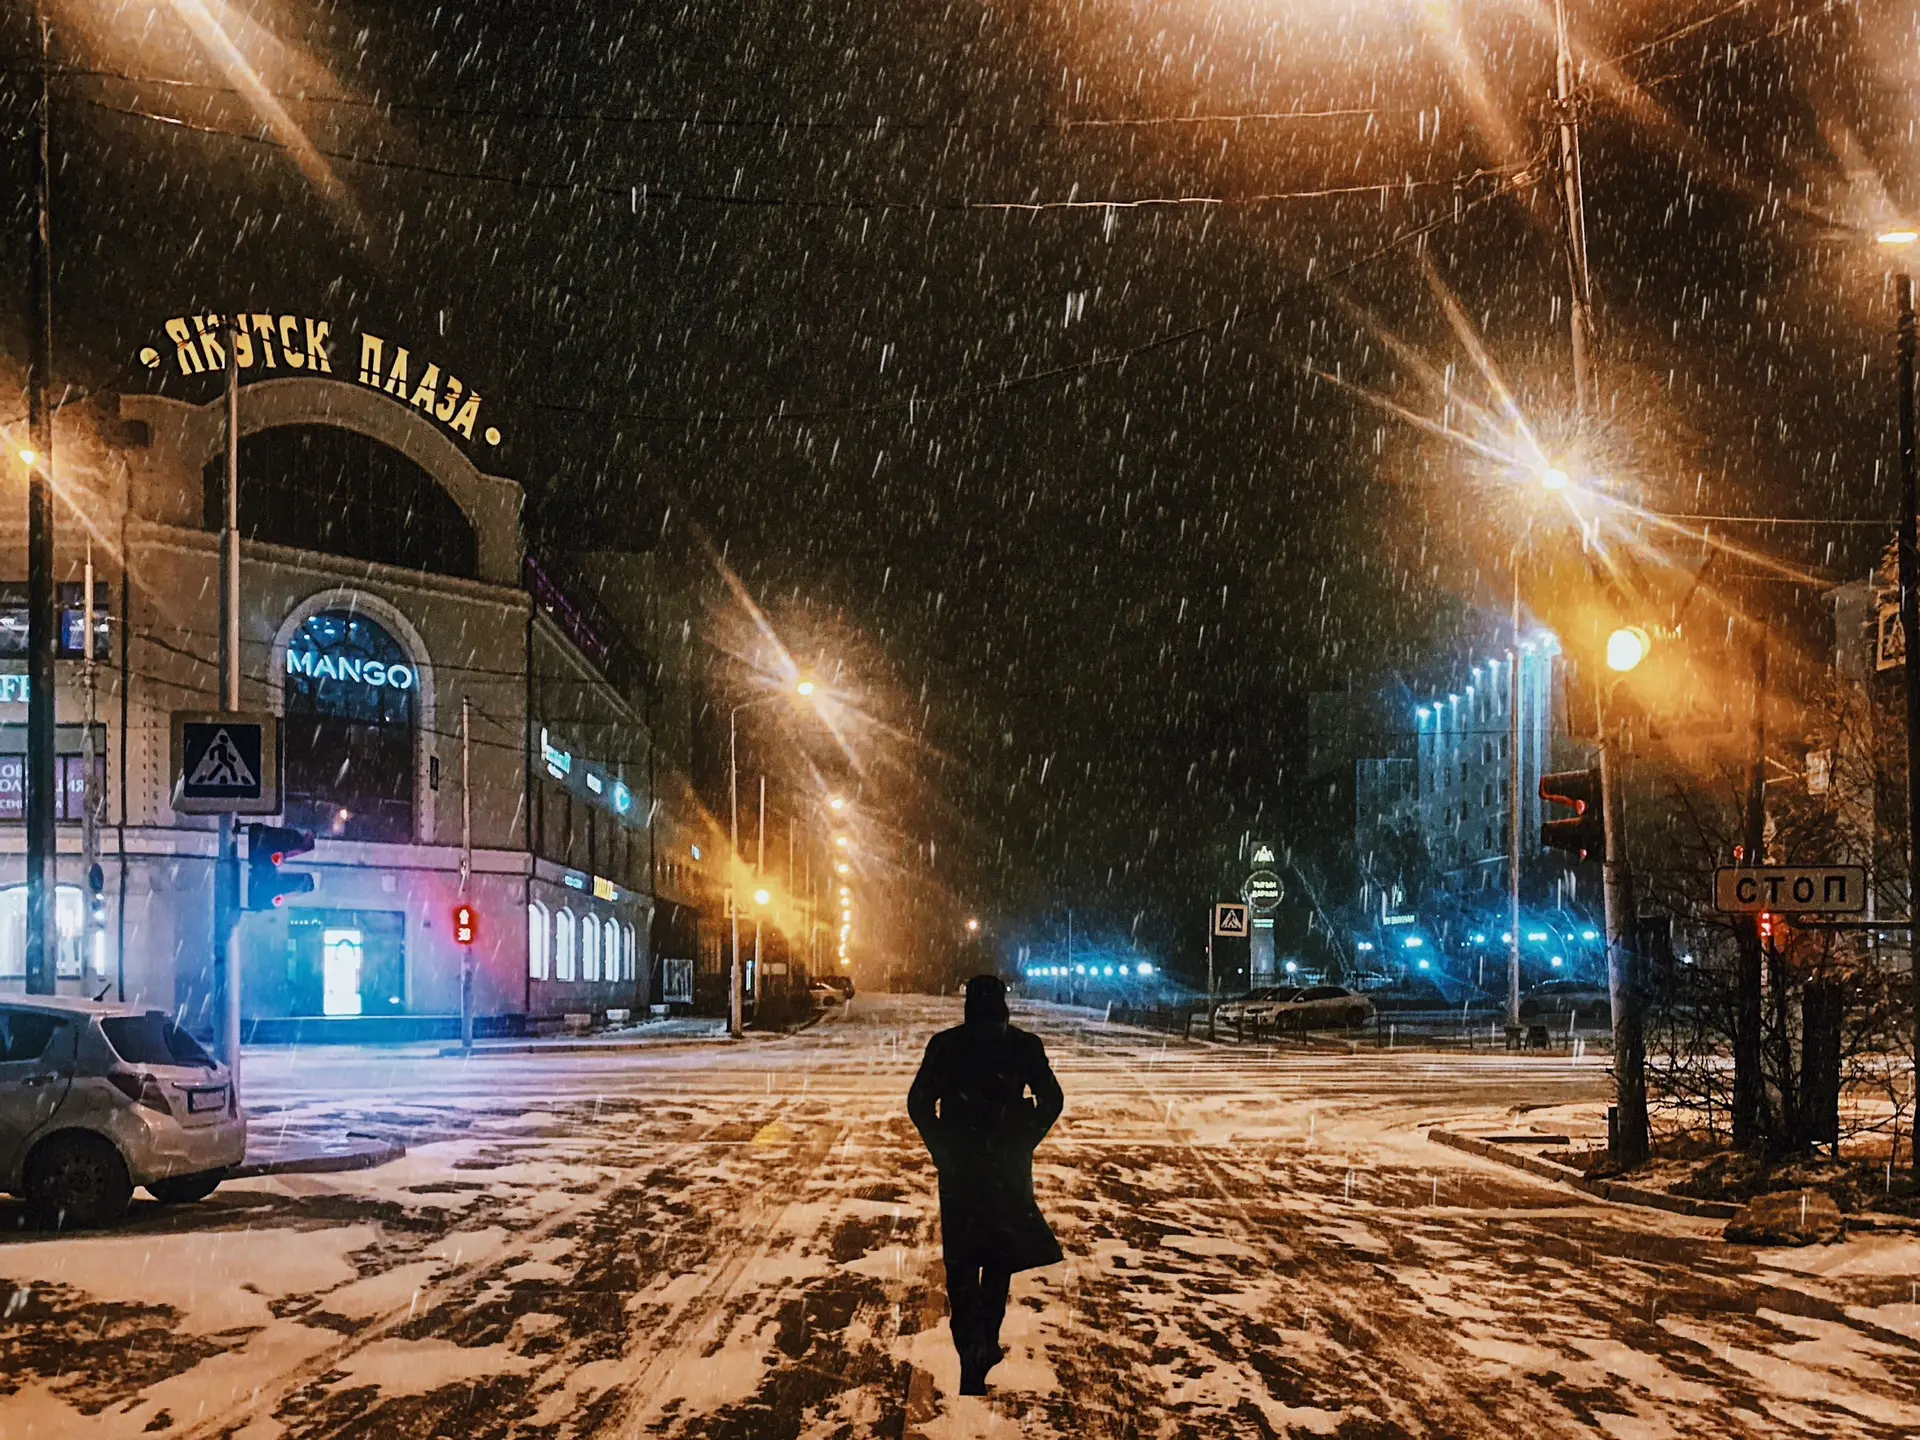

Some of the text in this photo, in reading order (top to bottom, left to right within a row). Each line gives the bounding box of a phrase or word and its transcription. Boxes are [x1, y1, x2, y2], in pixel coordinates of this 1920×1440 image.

[165, 313, 483, 440] ЯКУТСК ПЛАЗА
[286, 649, 412, 689] MANGO
[1736, 876, 1846, 903] СТОП
